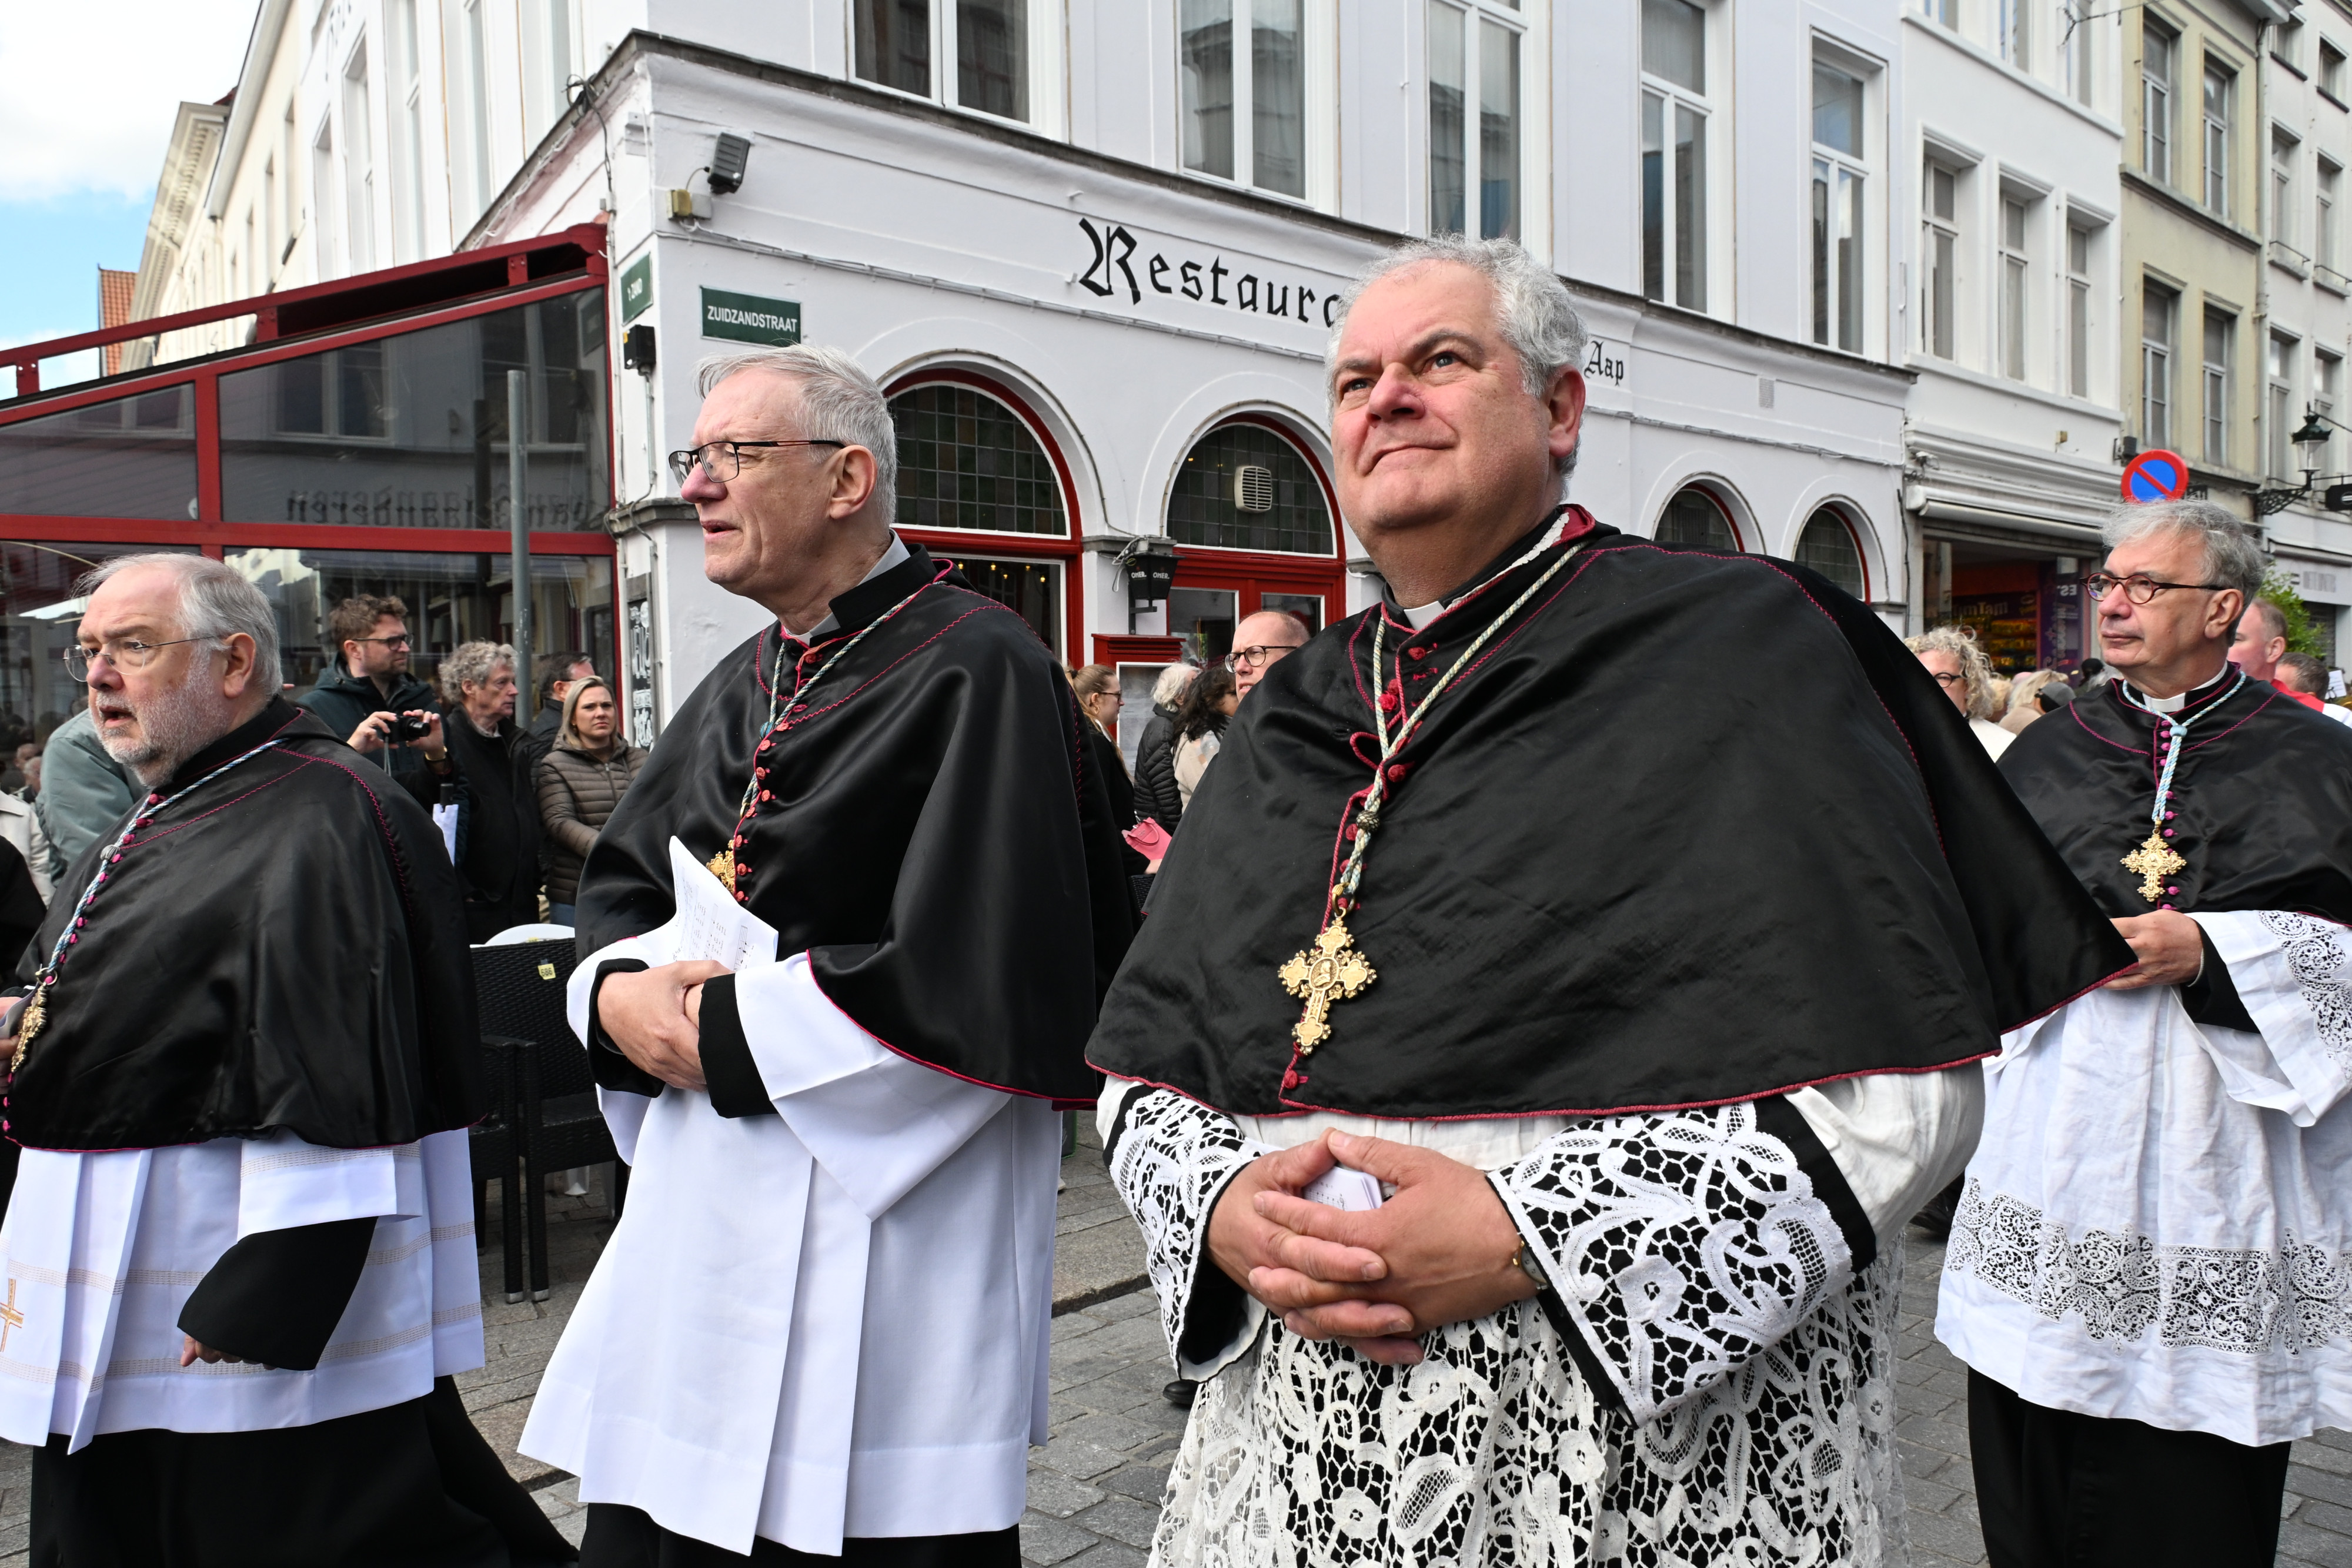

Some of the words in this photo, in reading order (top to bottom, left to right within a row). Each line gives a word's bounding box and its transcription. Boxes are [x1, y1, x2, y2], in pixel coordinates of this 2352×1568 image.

[707, 306, 797, 332] ZUIDZANDSTRAAT
[1583, 340, 1623, 387] Aap
[541, 968, 552, 976] 686
